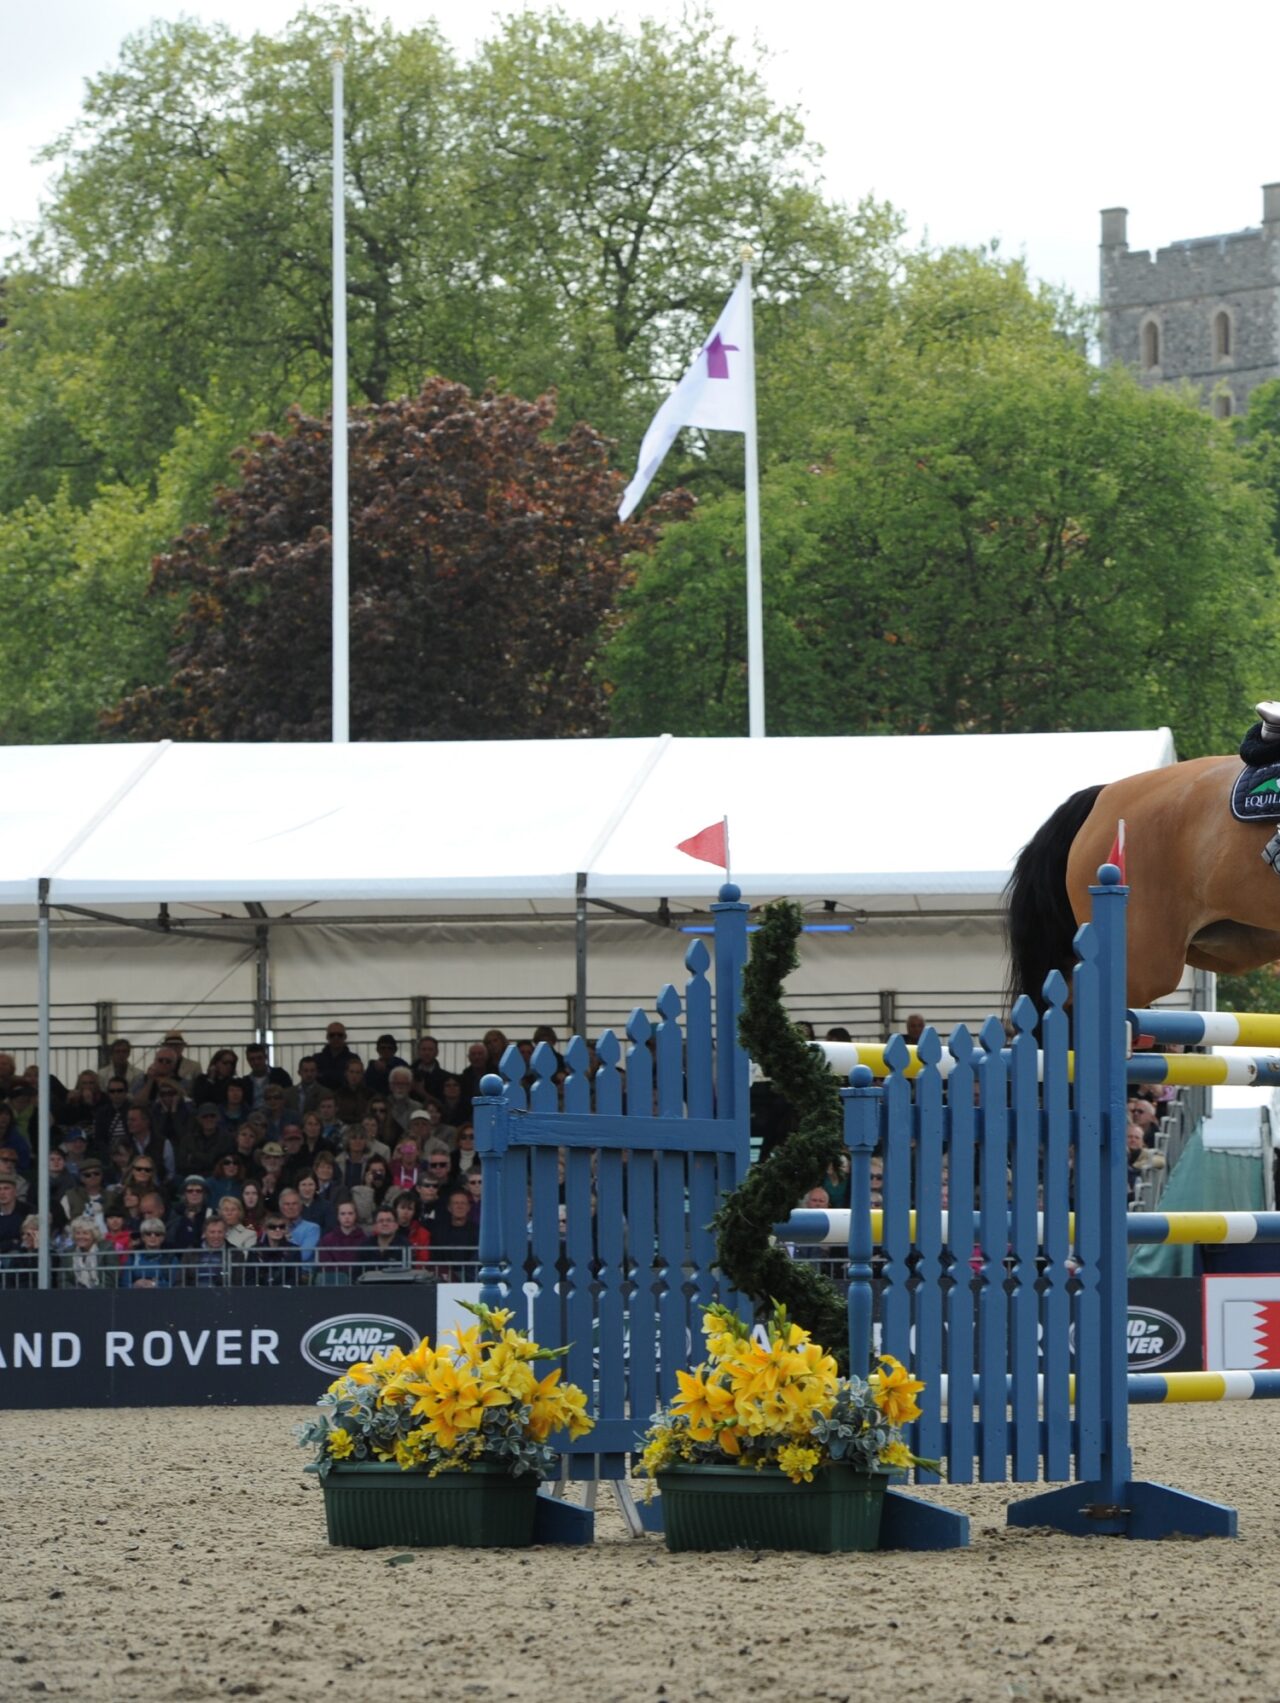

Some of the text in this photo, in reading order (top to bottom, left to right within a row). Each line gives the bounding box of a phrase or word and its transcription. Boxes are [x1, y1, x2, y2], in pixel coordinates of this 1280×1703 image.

[0, 1328, 280, 1369] ND ROVER
[326, 1327, 382, 1345] LAND
